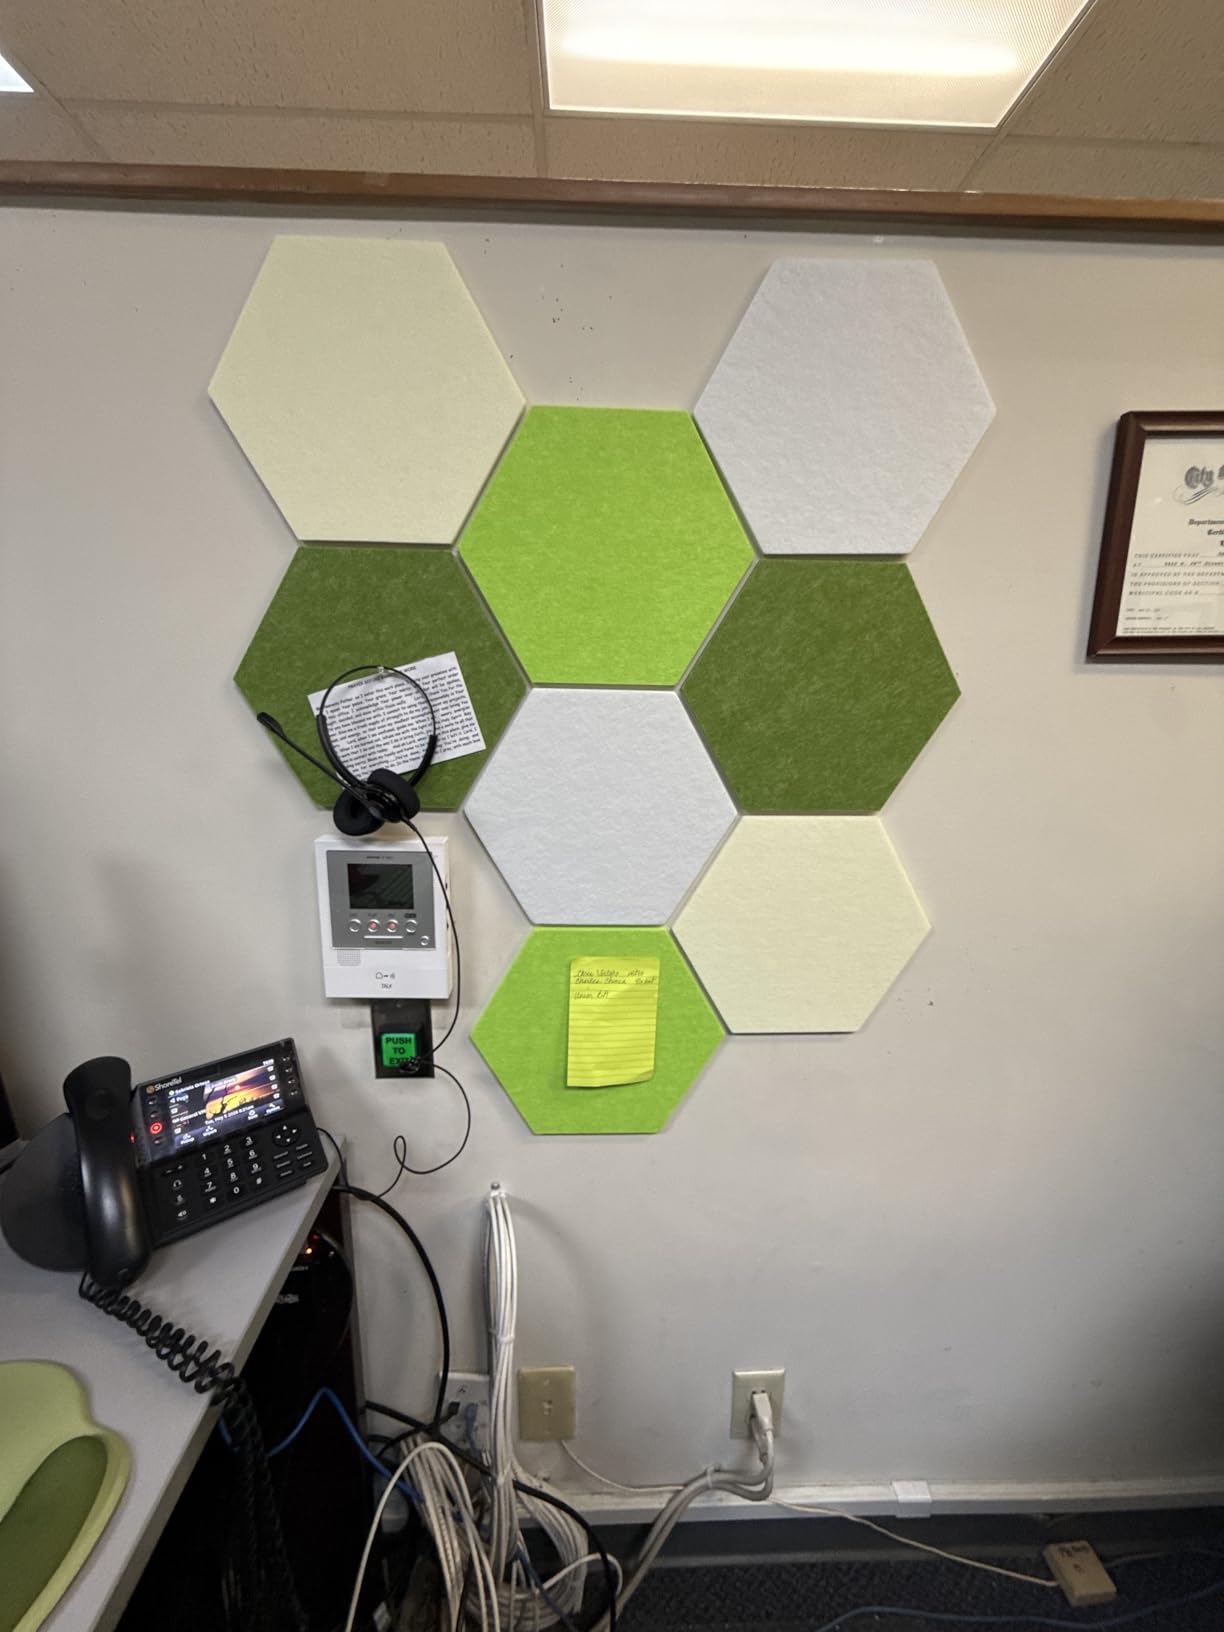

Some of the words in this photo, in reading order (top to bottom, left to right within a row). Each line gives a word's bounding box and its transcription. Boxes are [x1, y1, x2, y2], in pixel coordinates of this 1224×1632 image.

[385, 1036, 412, 1045] PUSH
[392, 1047, 406, 1055] TO
[154, 1076, 182, 1091] ShoreTel
[246, 1136, 252, 1144] 3
[223, 1144, 230, 1152] 2
[249, 1149, 256, 1157] 6
[206, 1181, 213, 1189] 7
[233, 1186, 240, 1194] 0
